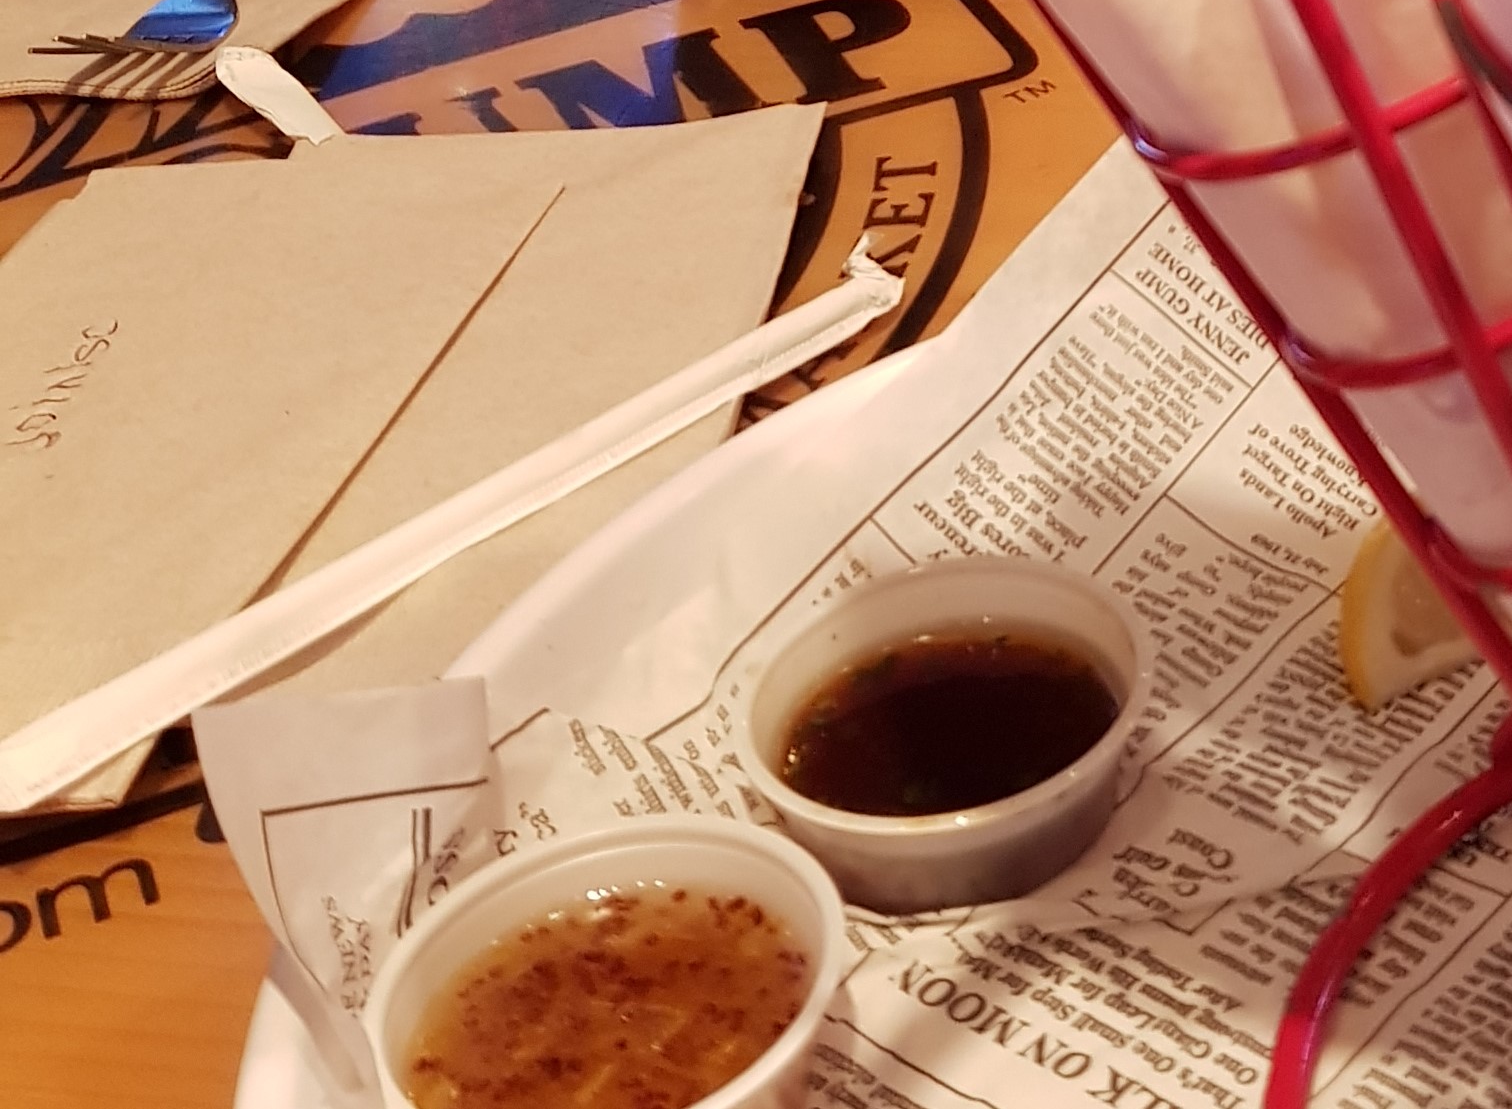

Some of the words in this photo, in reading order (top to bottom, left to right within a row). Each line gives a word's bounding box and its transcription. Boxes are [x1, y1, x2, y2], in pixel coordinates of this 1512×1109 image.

[1150, 244, 1205, 292] HOME
[1136, 270, 1190, 315] GUMP
[1202, 290, 1231, 312] AT
[1189, 314, 1249, 363] JENNY
[1227, 310, 1268, 349] DIES
[1183, 370, 1203, 389] day
[1166, 398, 1192, 422] Nice
[1248, 424, 1269, 438] of
[971, 451, 1005, 483] right
[1243, 445, 1289, 486] Target
[1270, 437, 1309, 474] Trove
[955, 464, 989, 497] right
[1003, 482, 1027, 504] the
[1240, 469, 1285, 508] Lands
[1292, 481, 1315, 503] On
[1312, 466, 1377, 516] Carrying
[946, 491, 982, 528] Big
[987, 495, 1010, 518] the
[1286, 504, 1335, 538] Apollo
[1316, 498, 1358, 530] Right
[998, 972, 1031, 996] for
[1070, 978, 1105, 1001] for
[892, 964, 1028, 1044] MOON
[1031, 988, 1075, 1020] Step
[1105, 992, 1155, 1029] Leap
[1020, 1035, 1091, 1078] ON
[1136, 1042, 1176, 1073] One
[1217, 1053, 1253, 1085] One
